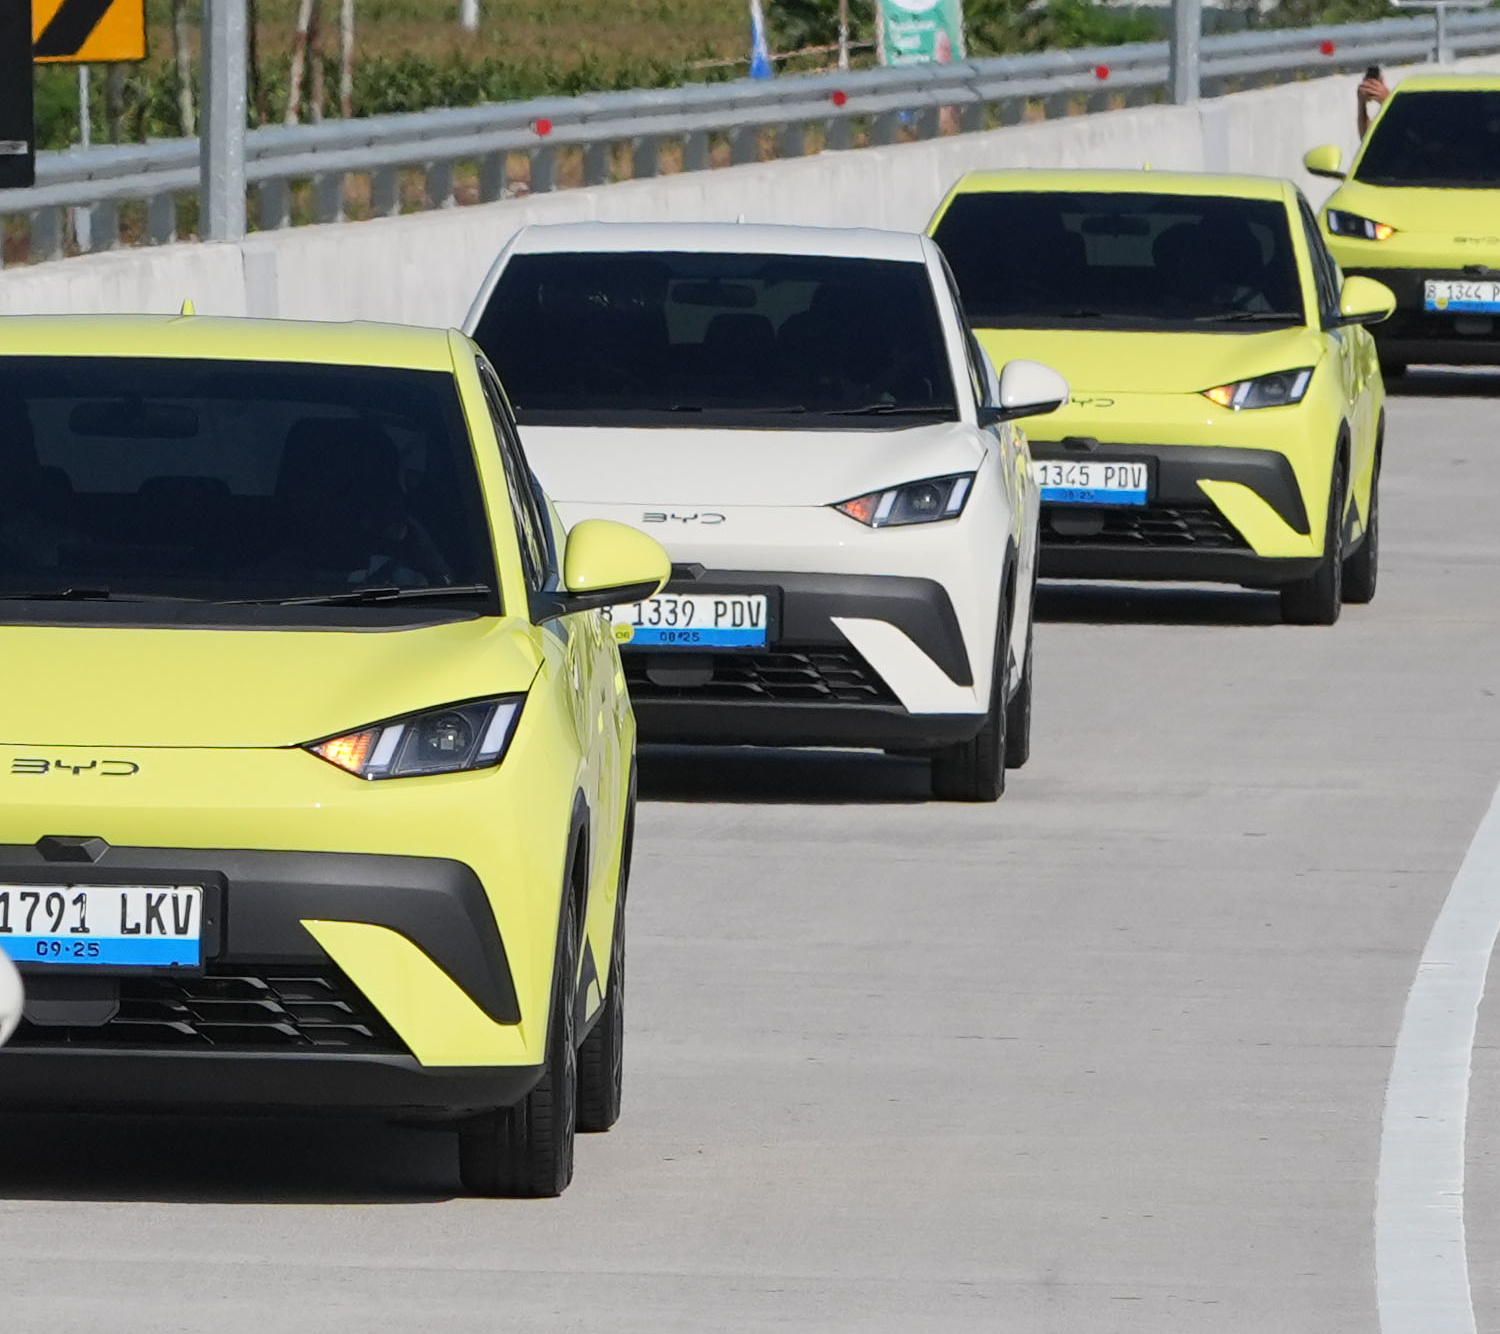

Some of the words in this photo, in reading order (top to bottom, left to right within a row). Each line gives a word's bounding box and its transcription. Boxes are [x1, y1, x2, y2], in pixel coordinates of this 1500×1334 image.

[1071, 397, 1115, 407] YD
[1039, 465, 1090, 486] 1345
[1104, 466, 1142, 488] PDV
[641, 512, 727, 524] BYD
[632, 599, 695, 627] 1339
[714, 601, 762, 628] PDV
[10, 758, 140, 776] BYD
[120, 893, 194, 935] LKV
